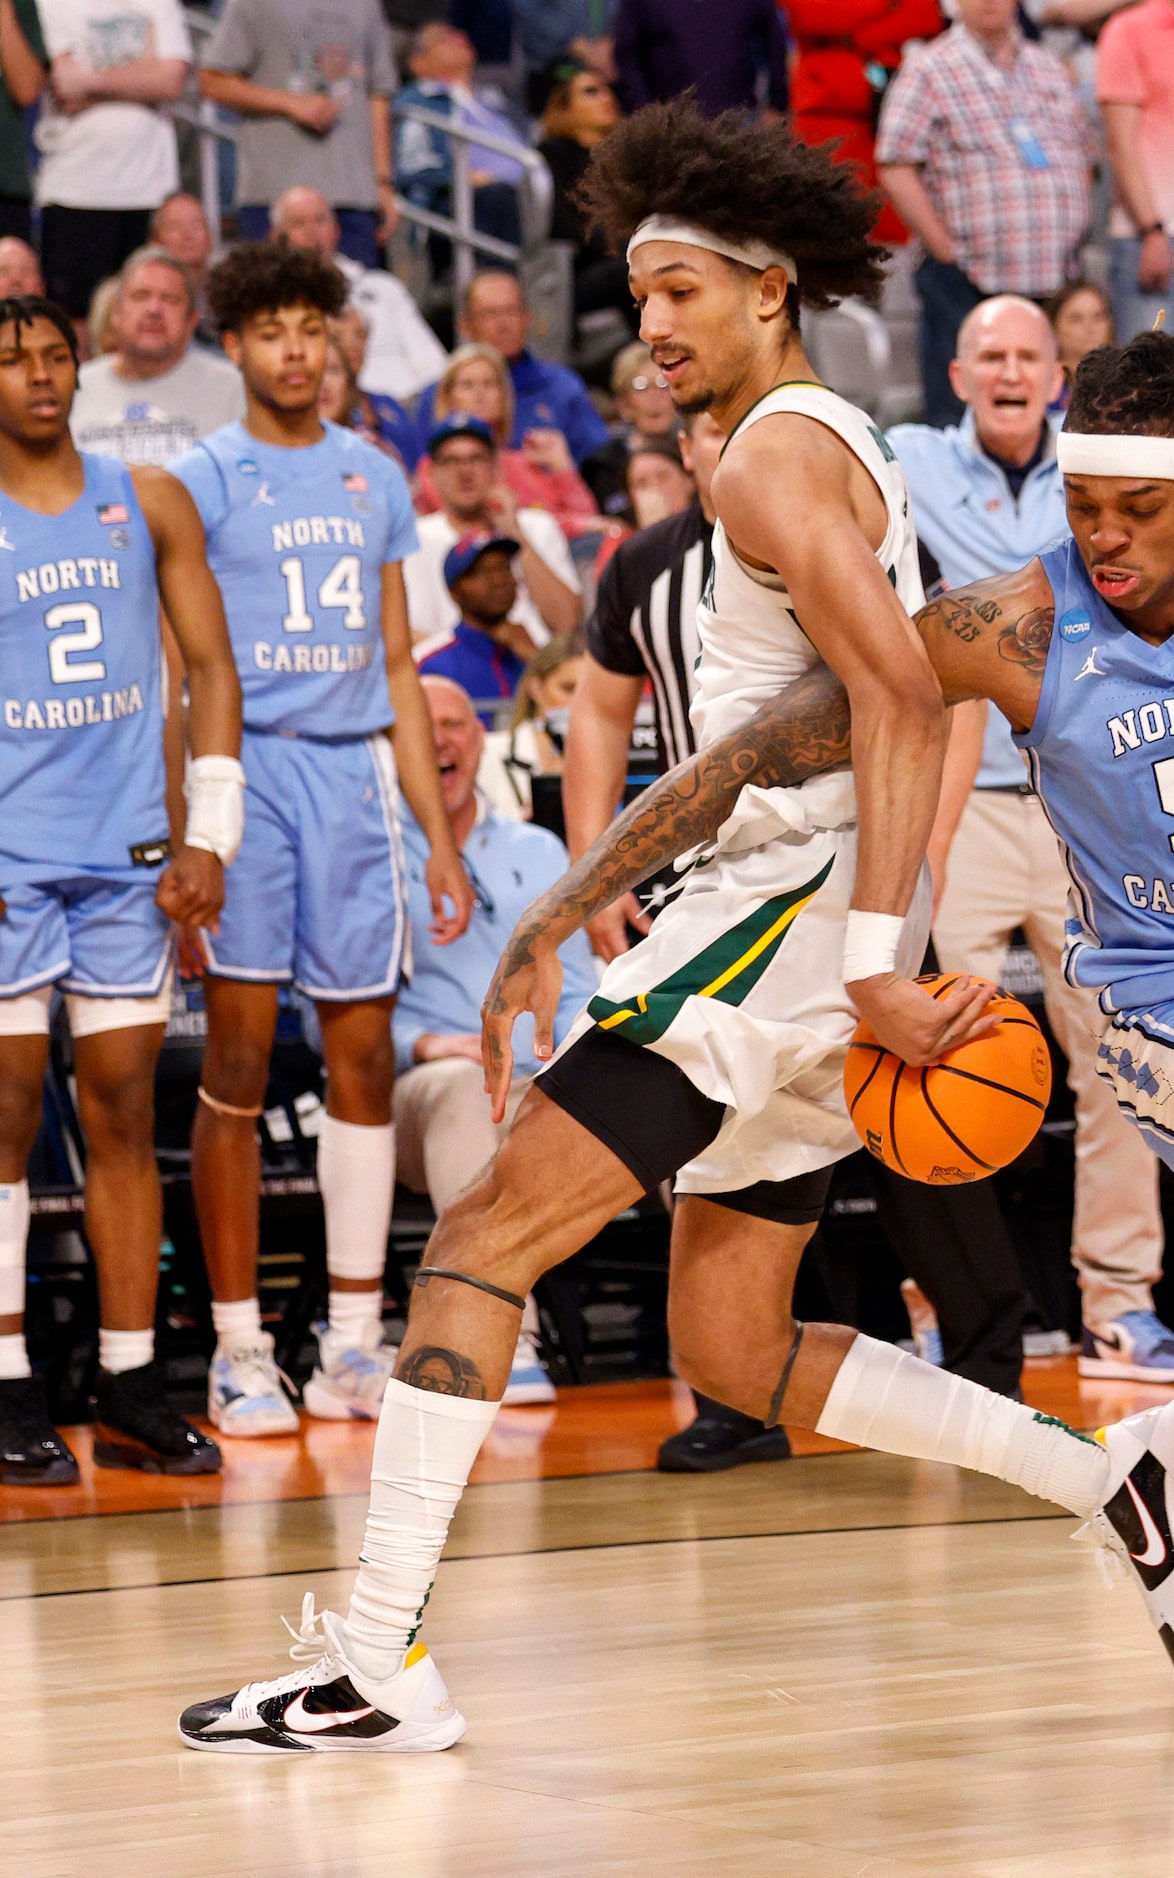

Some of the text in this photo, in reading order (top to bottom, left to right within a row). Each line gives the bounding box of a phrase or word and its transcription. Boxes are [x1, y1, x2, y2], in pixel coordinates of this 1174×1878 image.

[270, 515, 366, 552] NORTH
[16, 557, 121, 603] NORTH
[280, 554, 367, 633] 14
[44, 601, 107, 685] 2
[1063, 622, 1091, 635] NCAA
[4, 683, 145, 729] CAROLINA
